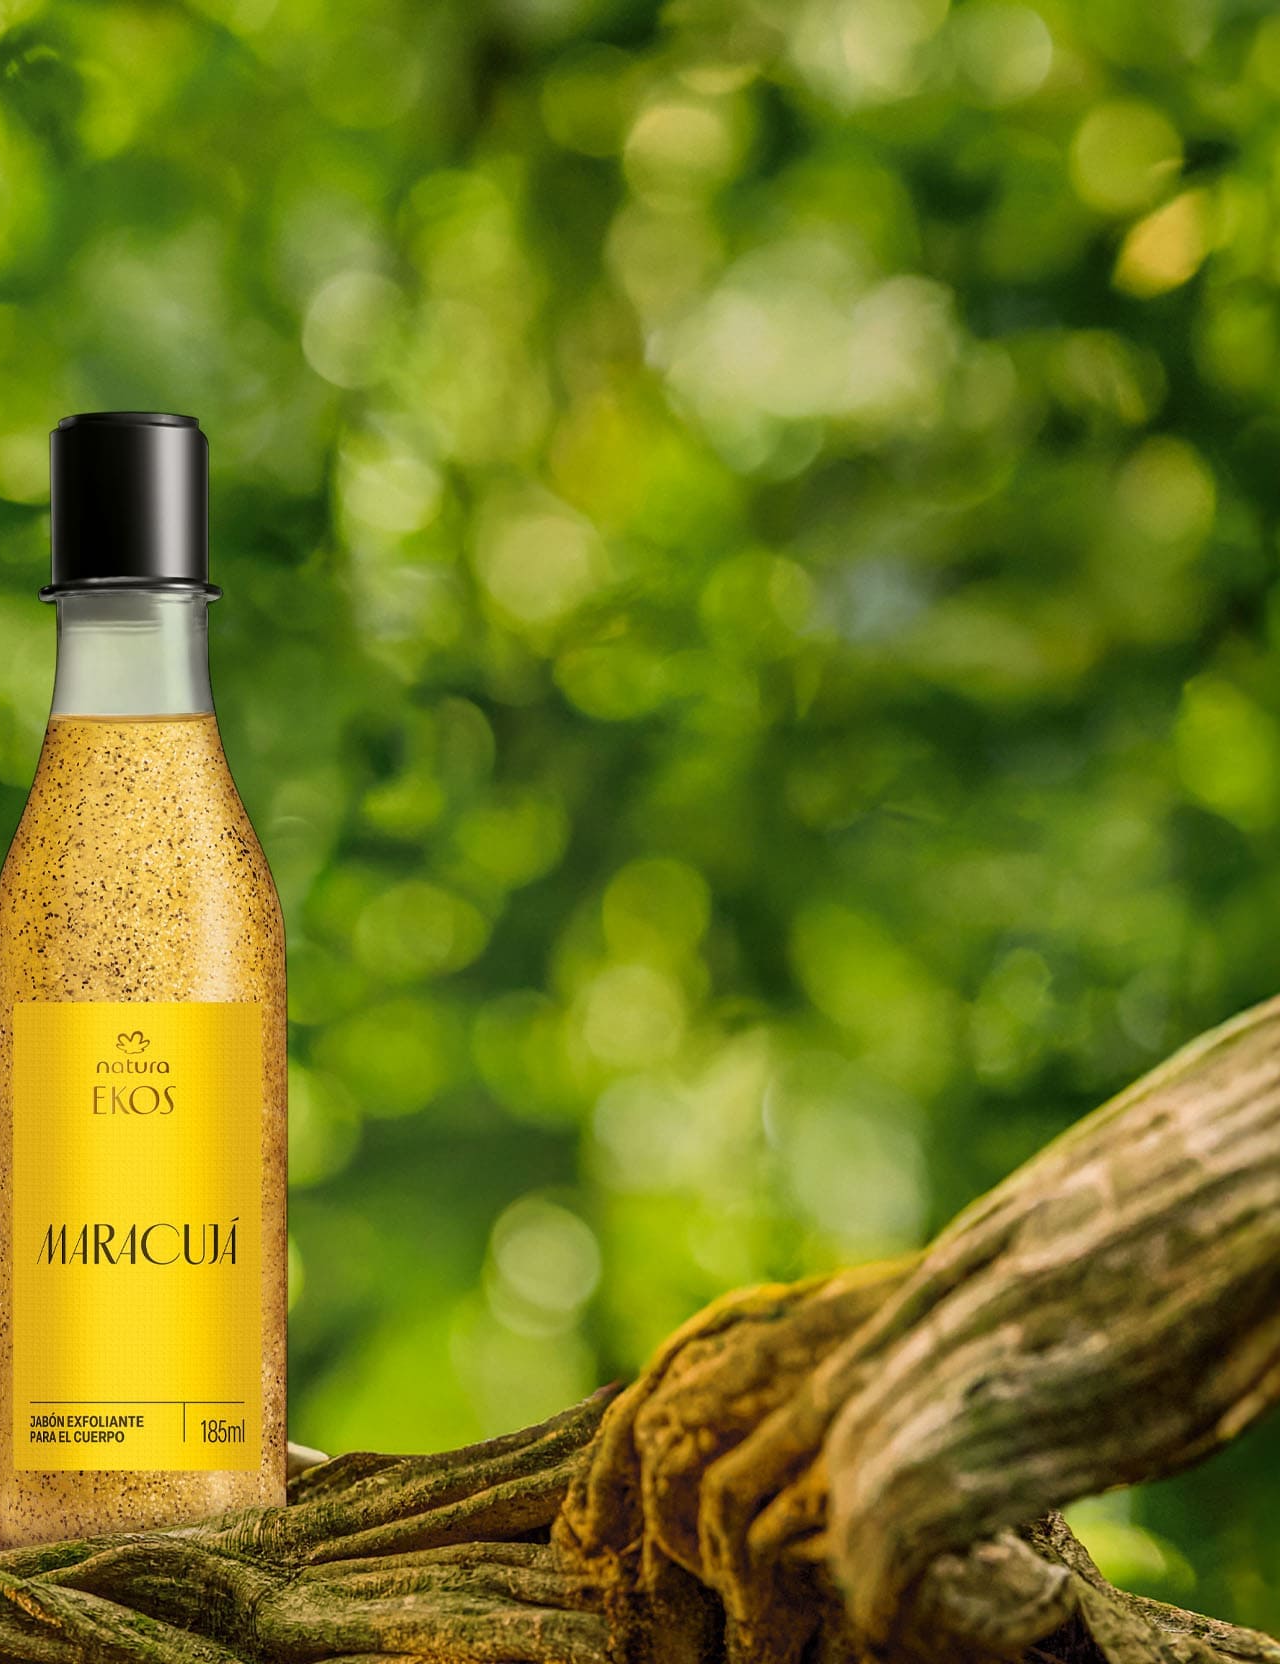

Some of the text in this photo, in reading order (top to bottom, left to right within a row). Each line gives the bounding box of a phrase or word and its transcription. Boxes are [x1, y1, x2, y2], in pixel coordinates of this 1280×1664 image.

[96, 1058, 170, 1074] natura
[93, 1085, 177, 1115] EKOS
[36, 1216, 240, 1265] MARACUJÁ
[30, 1412, 144, 1428] JABÓN EXFOLIANTE
[30, 1431, 125, 1443] PARA EL CUERPO
[200, 1419, 245, 1443] 185ml
